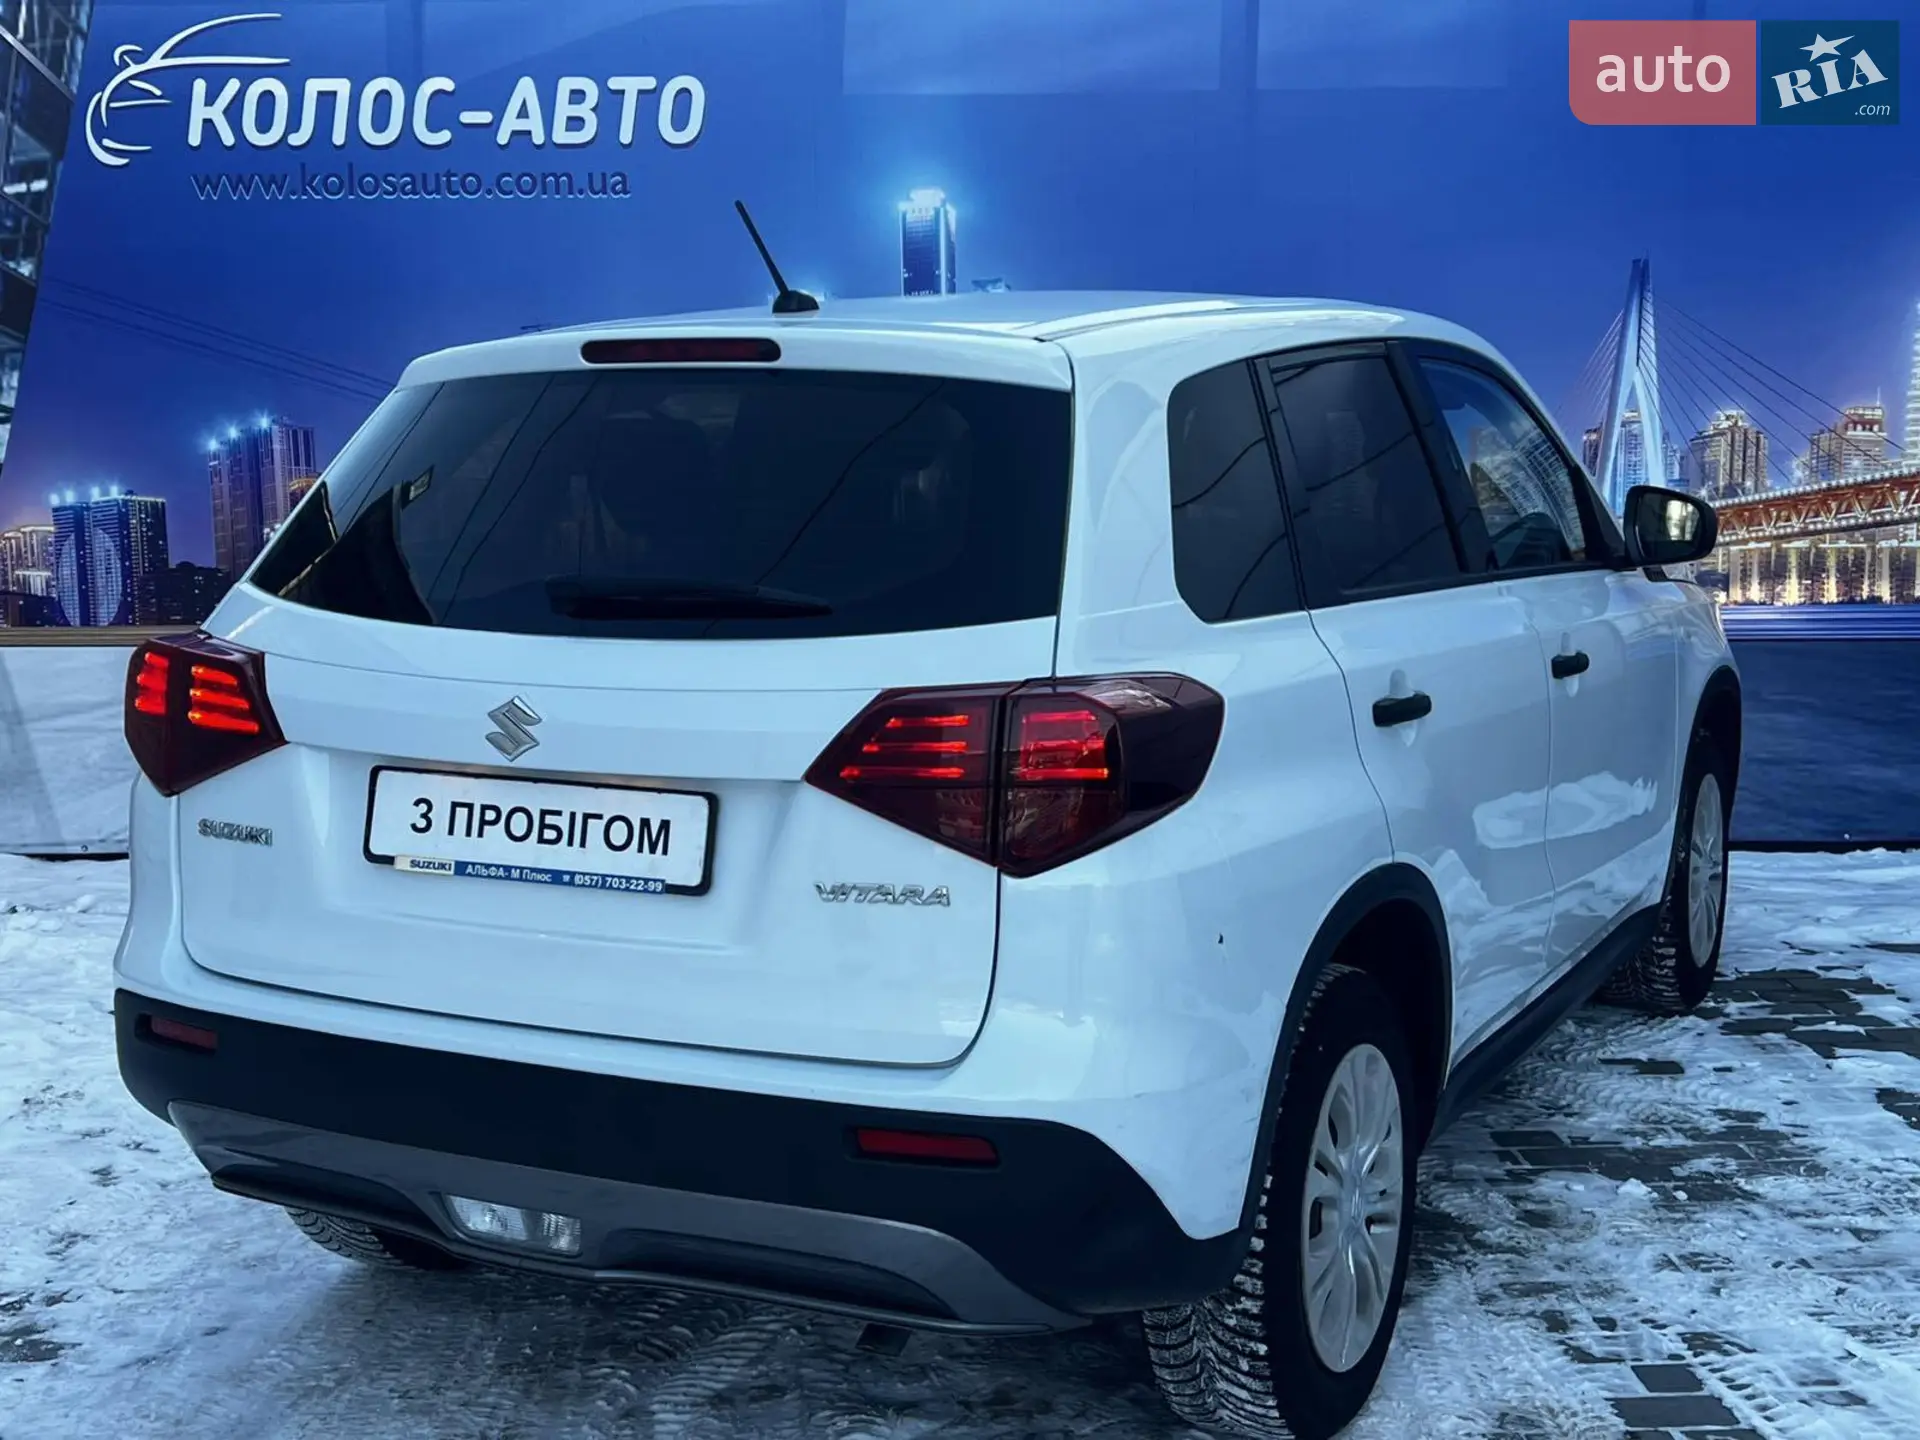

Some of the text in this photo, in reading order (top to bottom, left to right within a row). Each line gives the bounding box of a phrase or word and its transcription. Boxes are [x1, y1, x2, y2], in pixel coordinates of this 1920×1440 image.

[187, 76, 706, 148] КОЛОС-АВТО
[191, 163, 631, 201] www.kolosauto.com.ua
[198, 818, 273, 847] SUZUKI
[447, 800, 671, 856] ПРОБІГОМ
[409, 858, 452, 872] SUZUKI
[522, 871, 553, 884] Плюс
[574, 874, 602, 887] (057)
[605, 877, 663, 893] 703-22-99
[814, 882, 951, 907] VITARA
